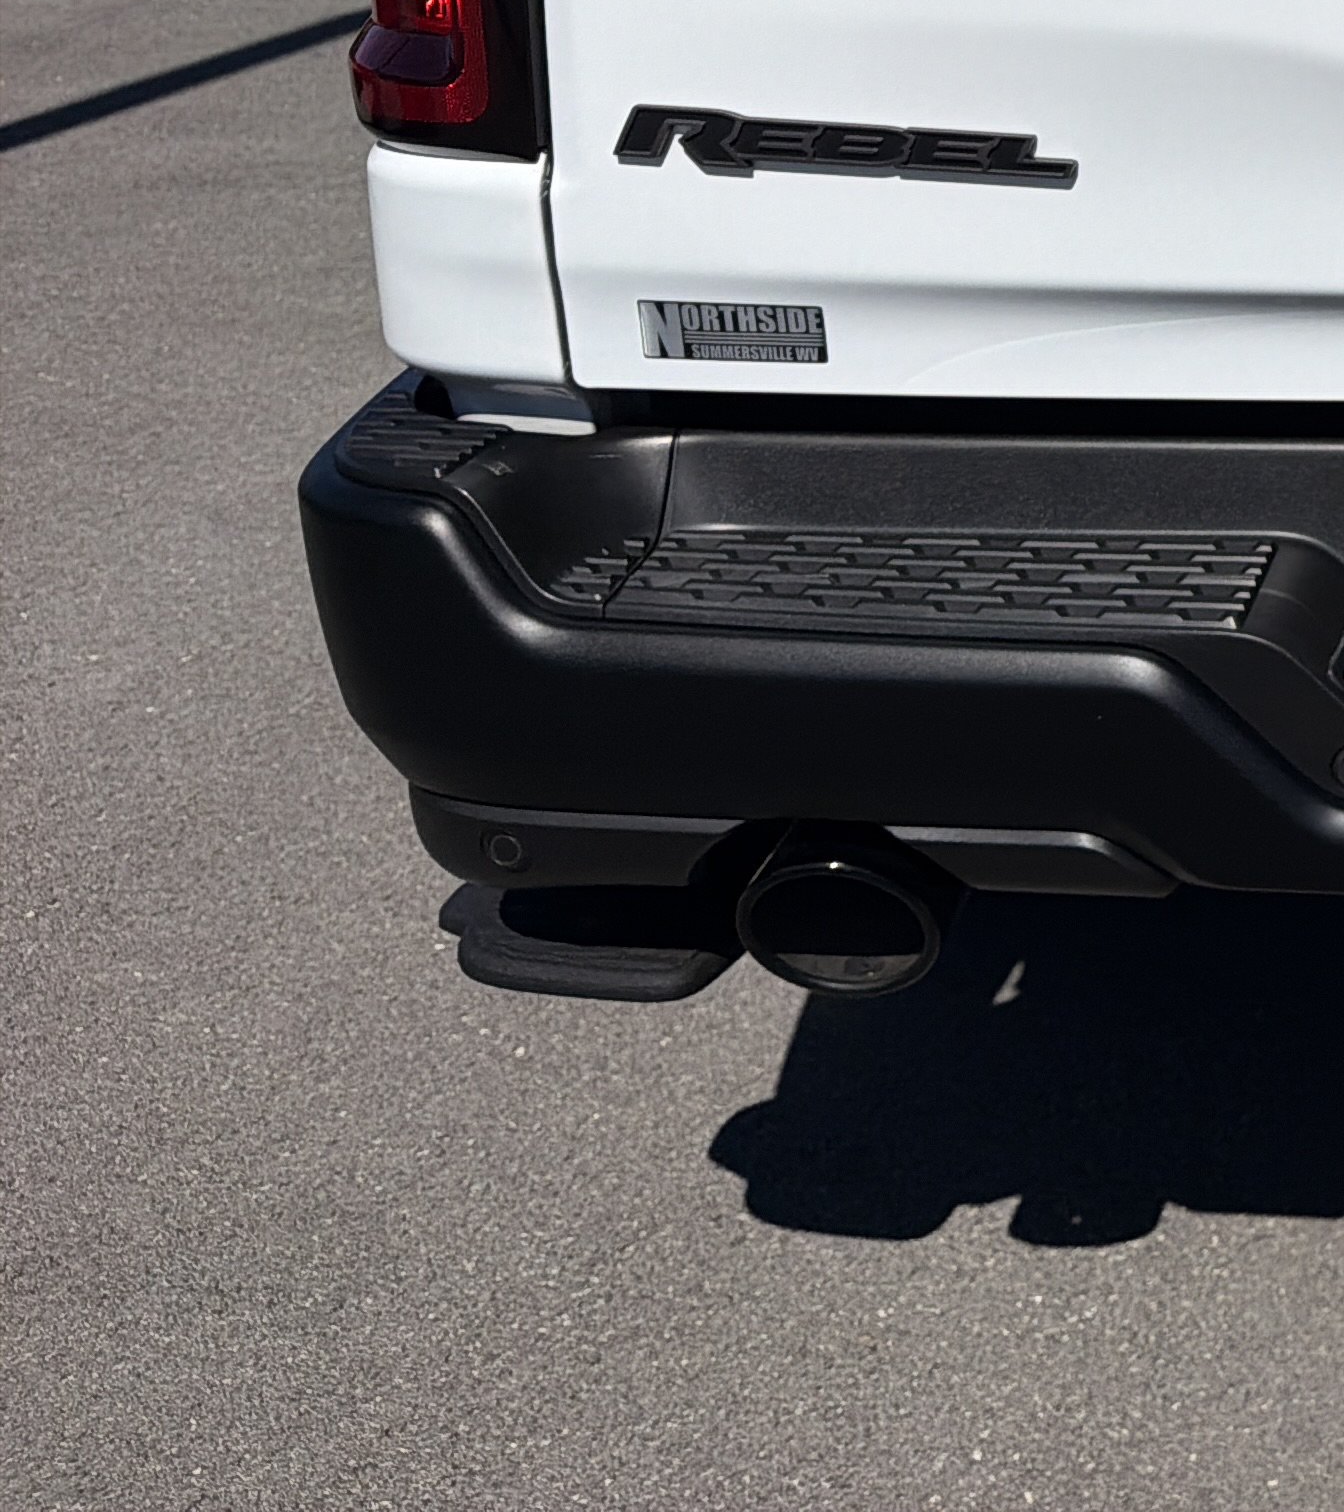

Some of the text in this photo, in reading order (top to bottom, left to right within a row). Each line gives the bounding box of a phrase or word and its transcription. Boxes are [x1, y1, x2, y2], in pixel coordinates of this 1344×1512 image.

[613, 104, 1079, 190] REBEL
[639, 302, 824, 359] NORTHSIDE
[691, 343, 819, 362] SUMMERSVILLE WV
